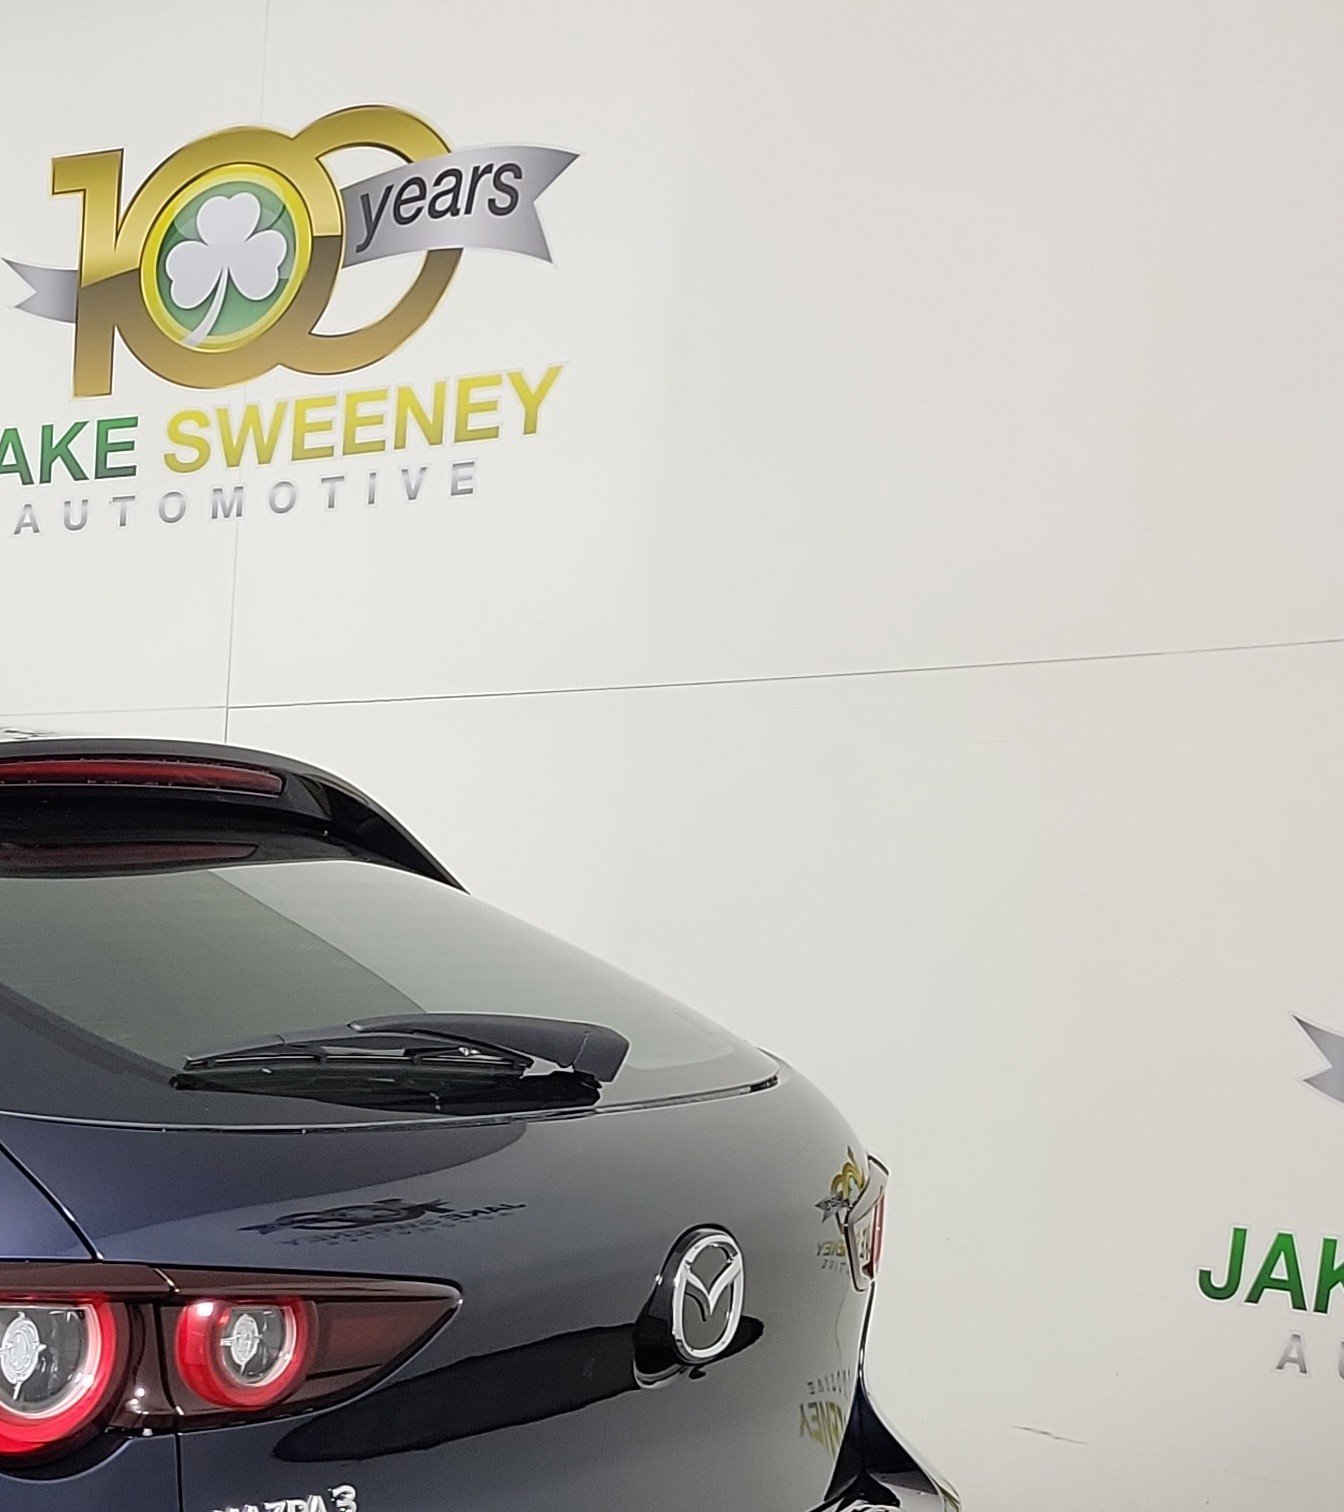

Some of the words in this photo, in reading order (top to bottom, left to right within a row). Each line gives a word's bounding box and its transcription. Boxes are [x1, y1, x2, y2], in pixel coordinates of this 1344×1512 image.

[356, 162, 523, 253] years
[163, 363, 567, 474] SWEENEY
[12, 461, 477, 537] AUTOMOTIVE
